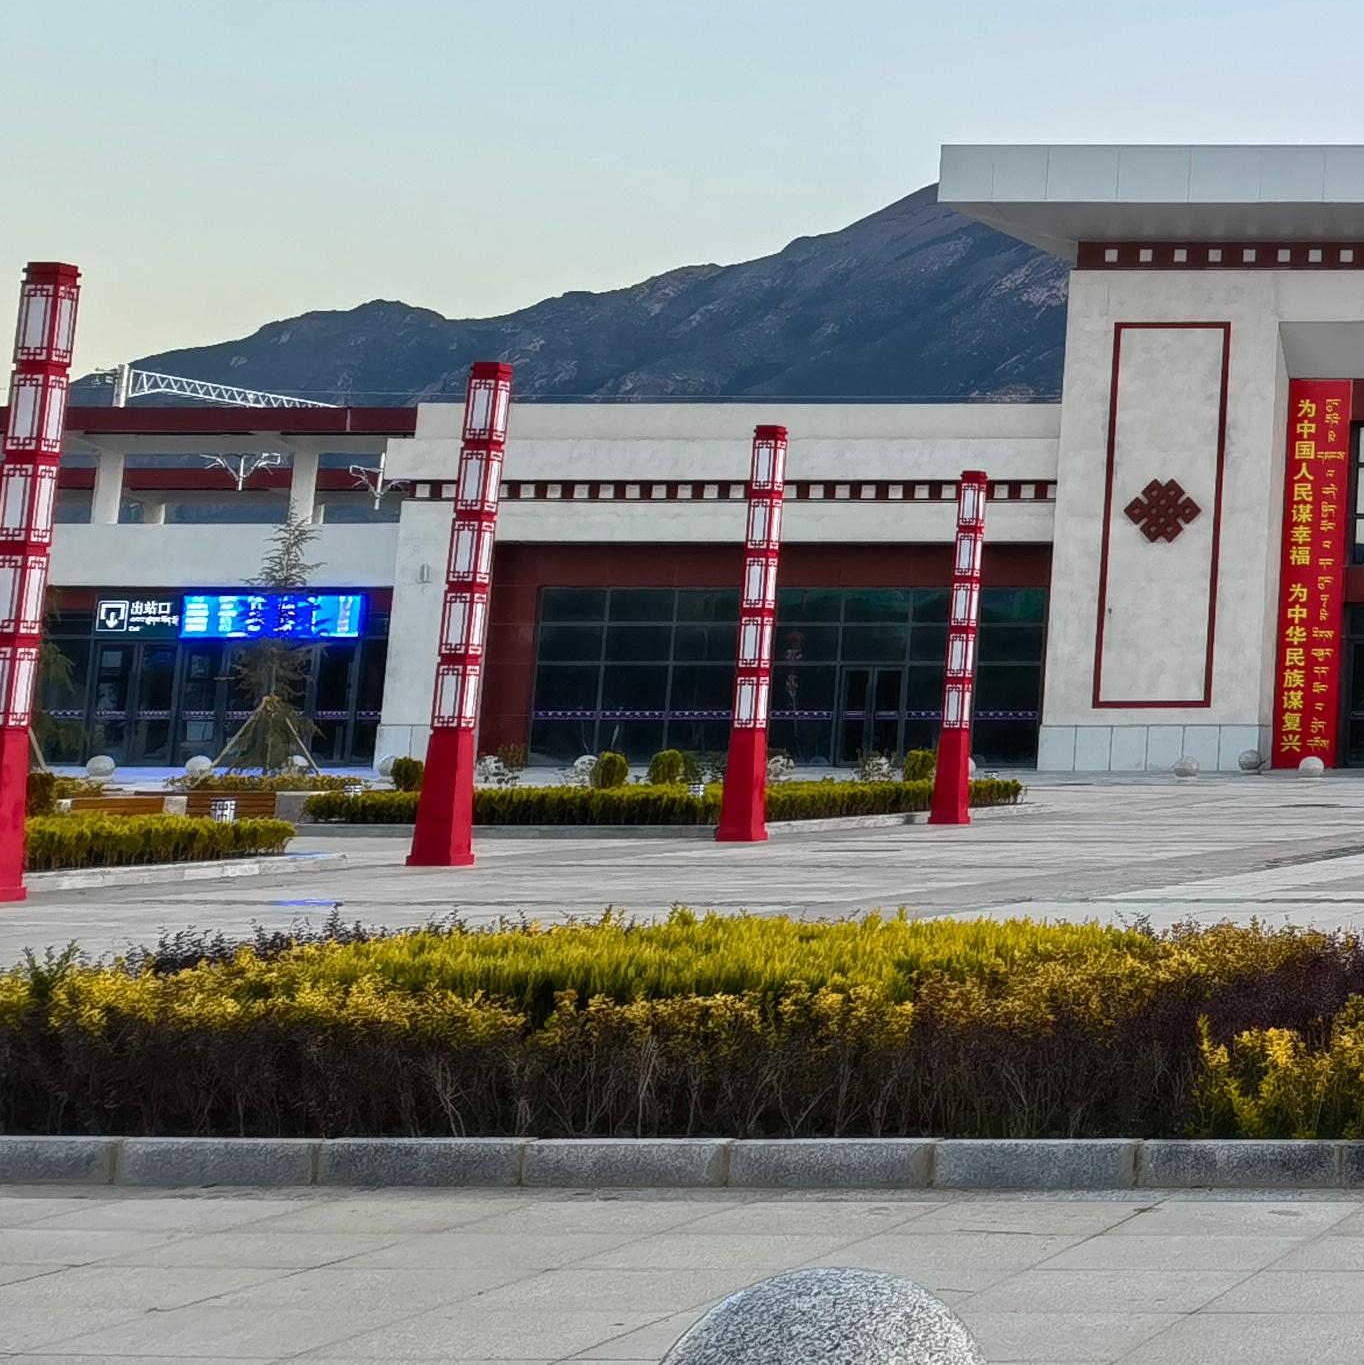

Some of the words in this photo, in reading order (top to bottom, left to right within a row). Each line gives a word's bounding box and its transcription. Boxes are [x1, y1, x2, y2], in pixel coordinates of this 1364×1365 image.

[1289, 399, 1316, 566] 为中国人民谋幸福
[130, 600, 171, 615] 出站口
[1280, 583, 1308, 753] 为中华民族谋复兴
